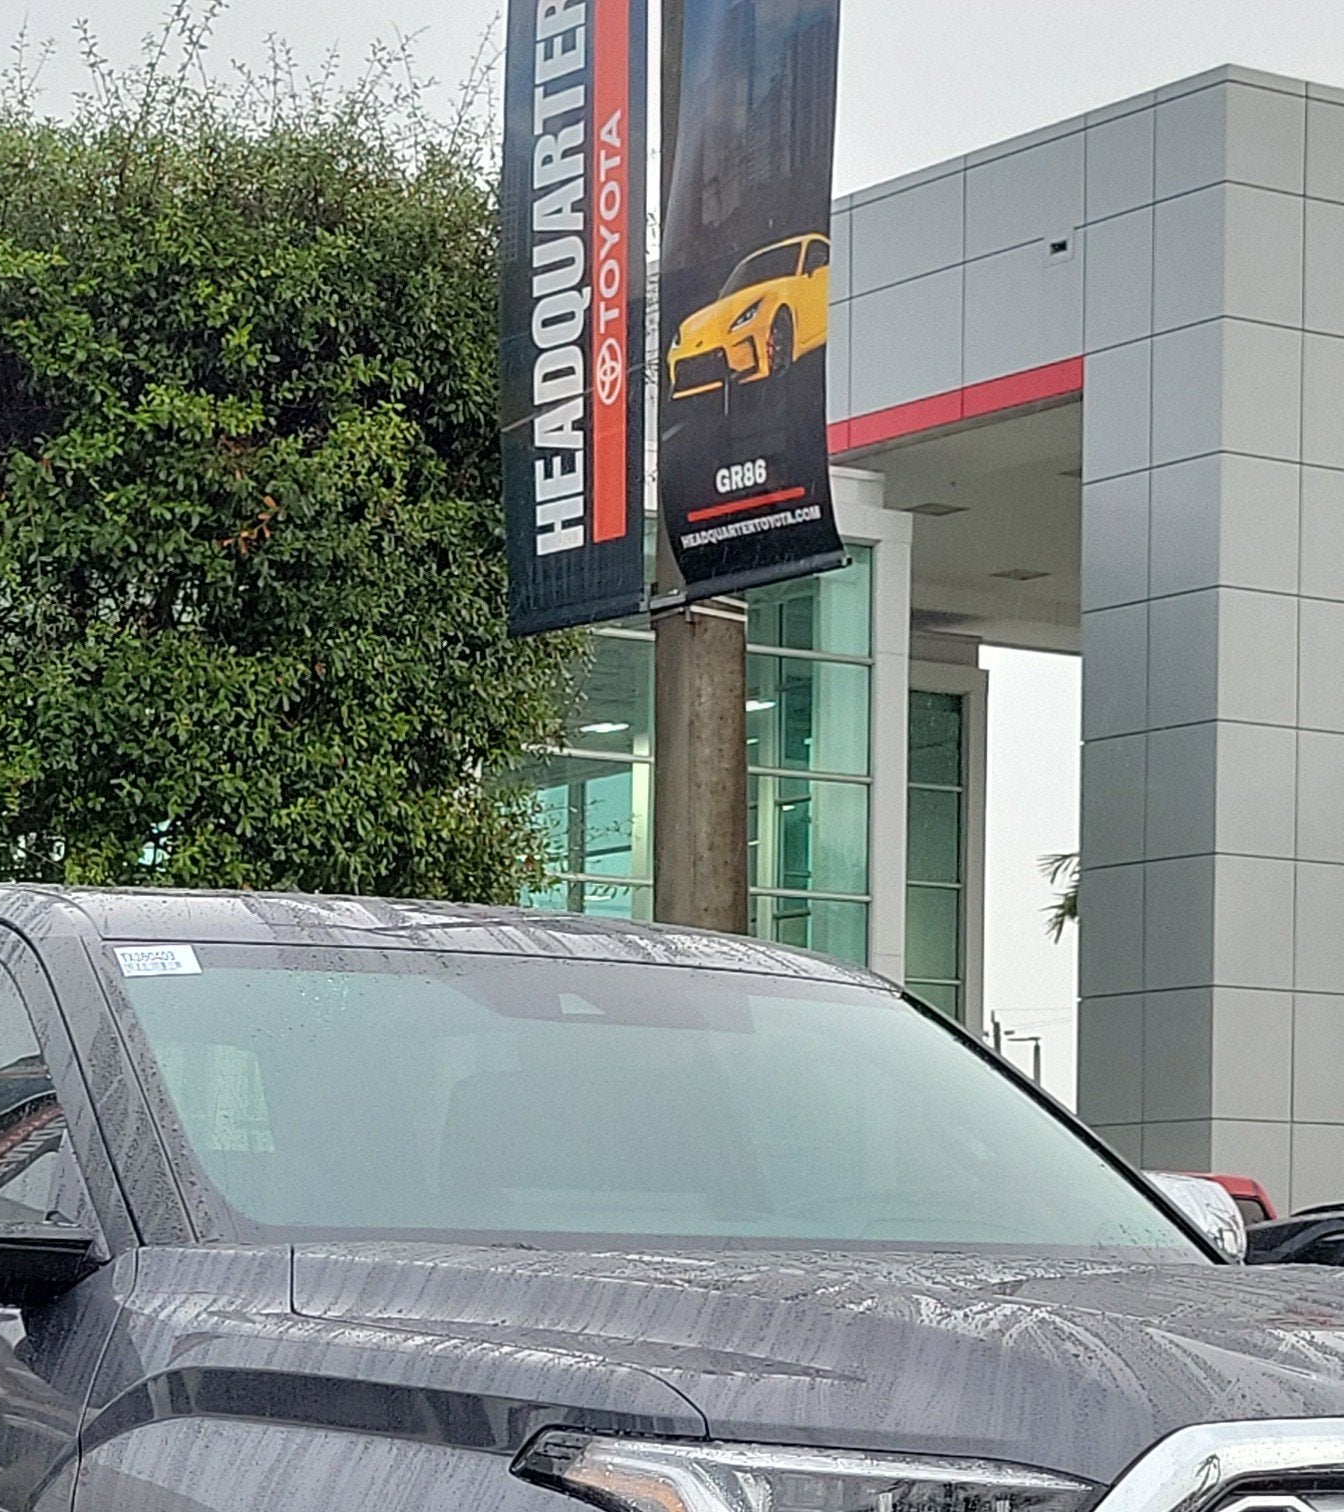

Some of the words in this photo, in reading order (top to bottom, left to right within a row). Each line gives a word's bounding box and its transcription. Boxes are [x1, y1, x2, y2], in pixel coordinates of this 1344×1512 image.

[531, 0, 591, 556] HEADQUARTER
[599, 109, 621, 334] TOYOTA
[680, 504, 822, 550] HEADQUARTERTOYOTA.COM
[715, 458, 768, 494] GR86
